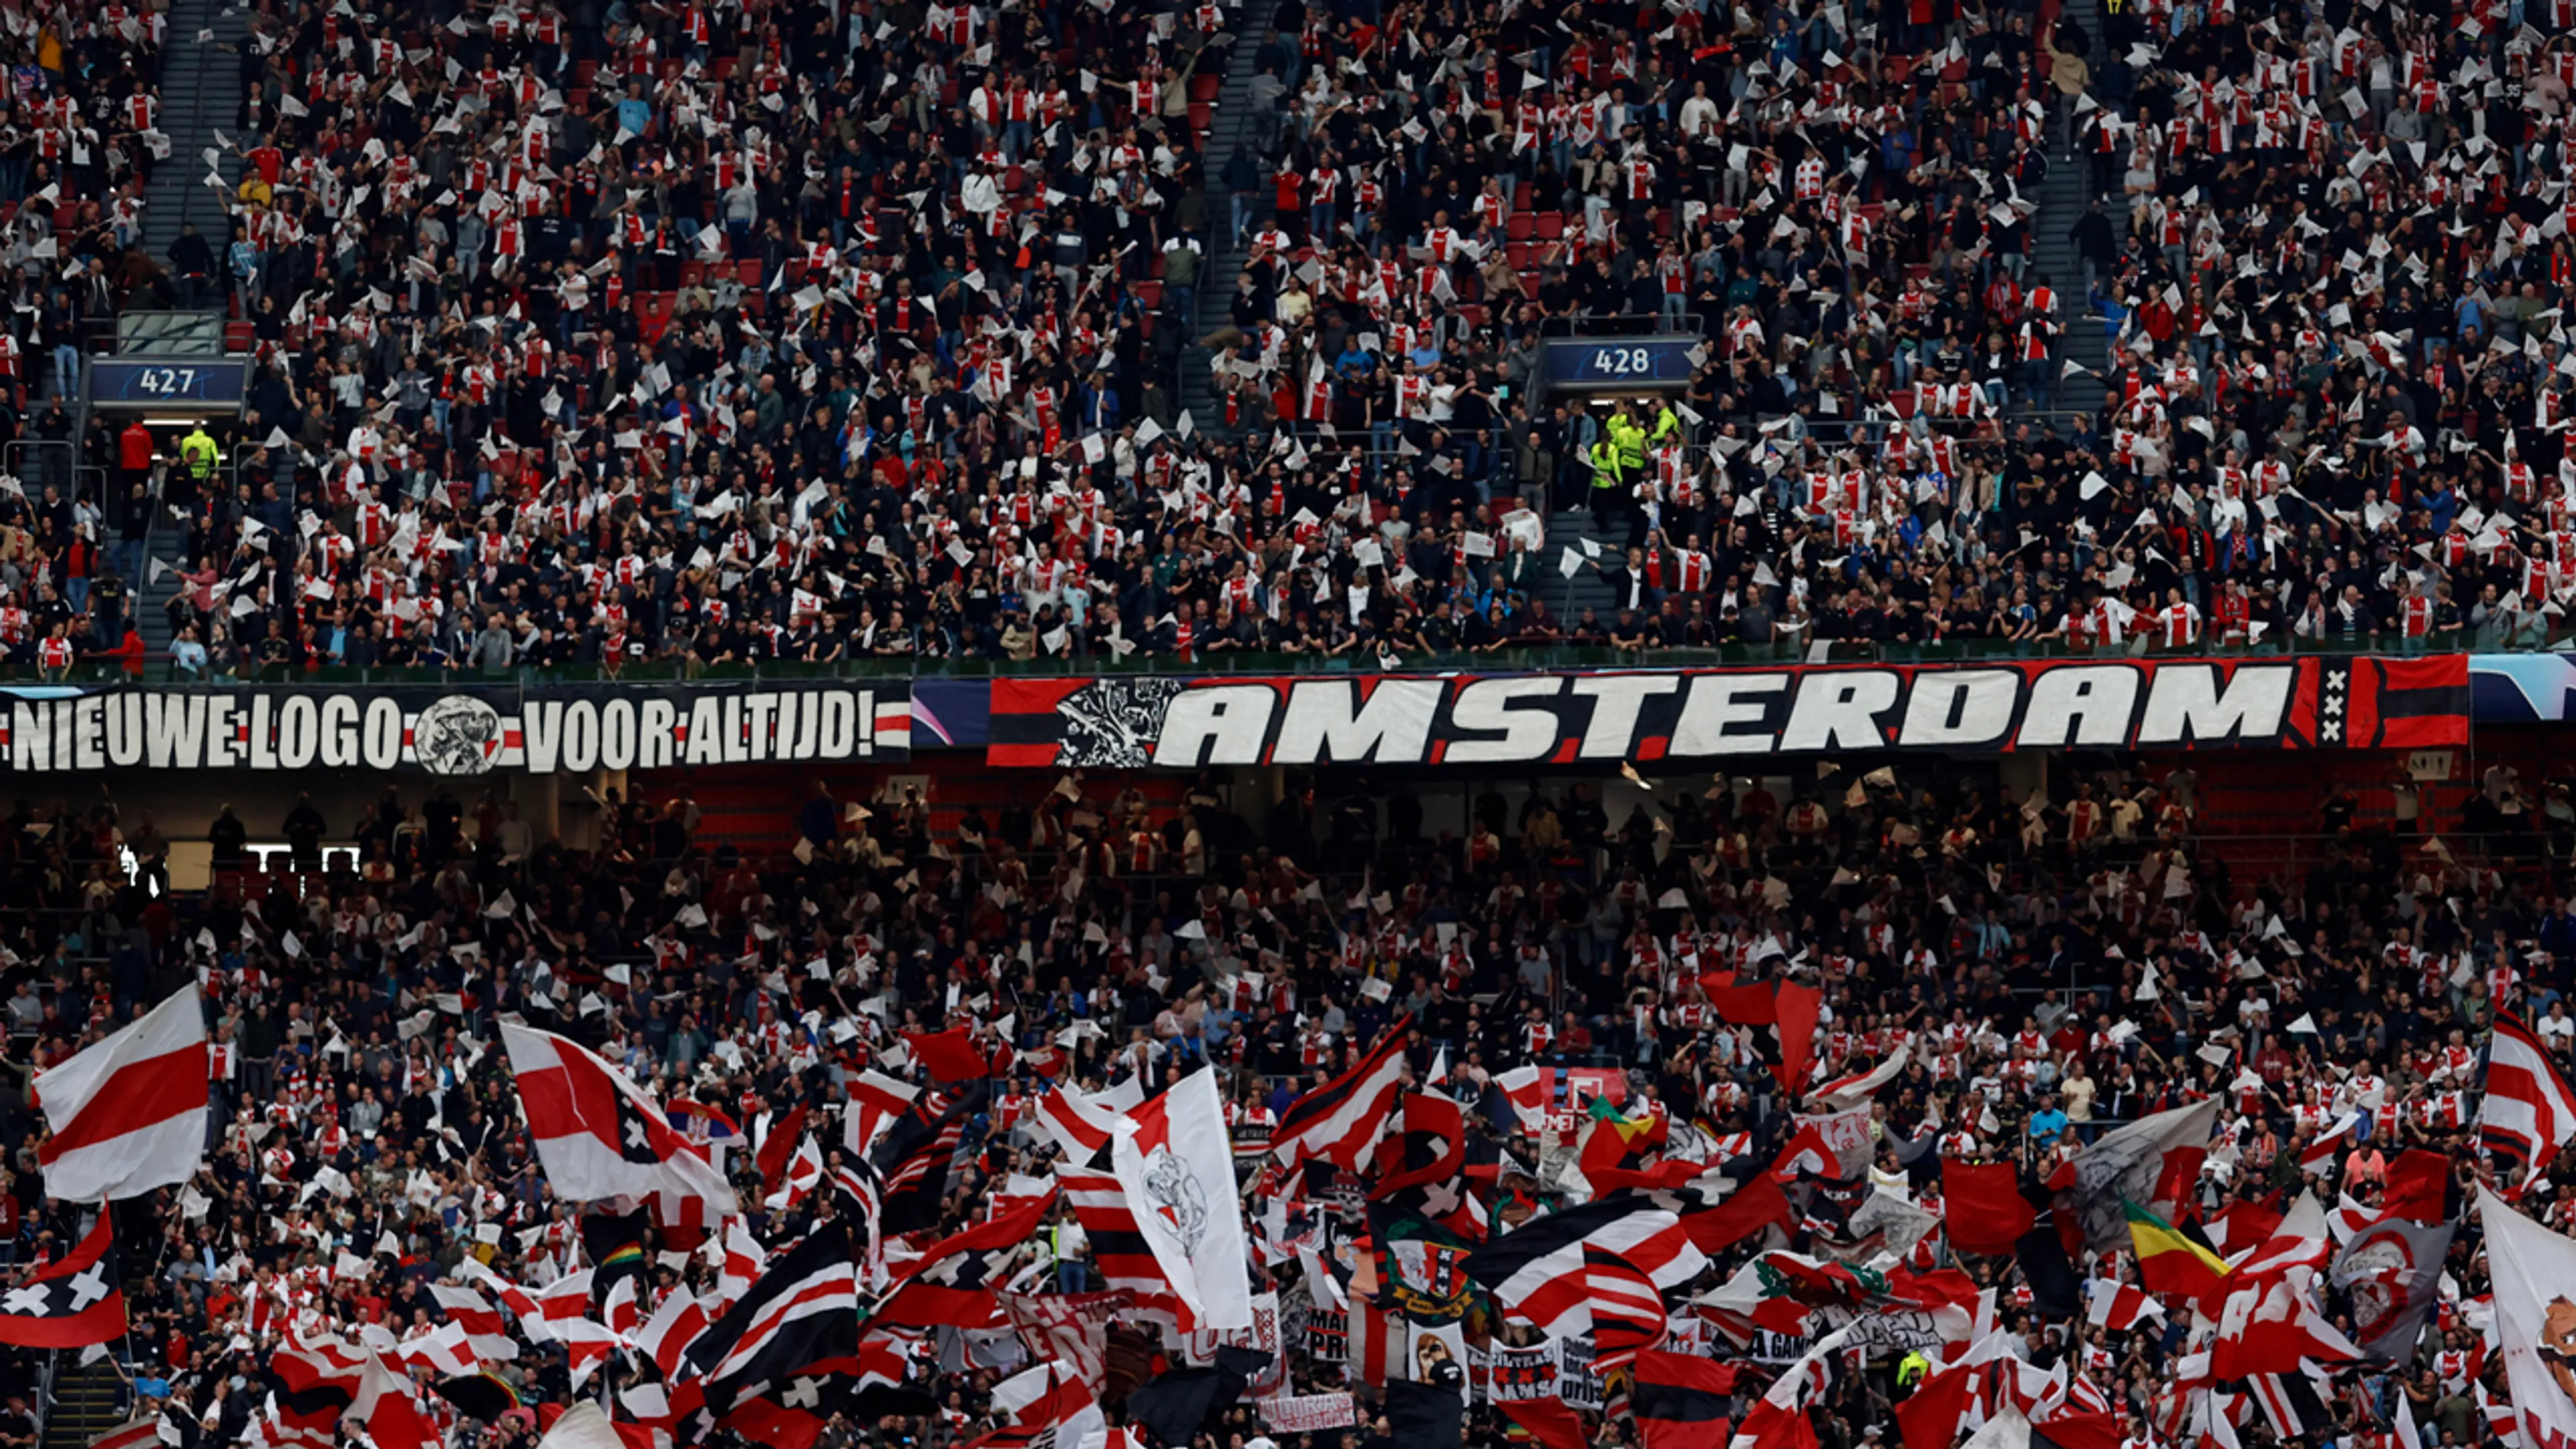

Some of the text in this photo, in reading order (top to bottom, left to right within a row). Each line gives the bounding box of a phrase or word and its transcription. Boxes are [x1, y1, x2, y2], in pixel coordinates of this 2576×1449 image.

[140, 368, 195, 393] 427
[1595, 347, 1649, 373] 428
[13, 690, 873, 773] NIEUWE LOGO VOOR ALTIJD!
[1152, 665, 2294, 765] AMSTERDAM
